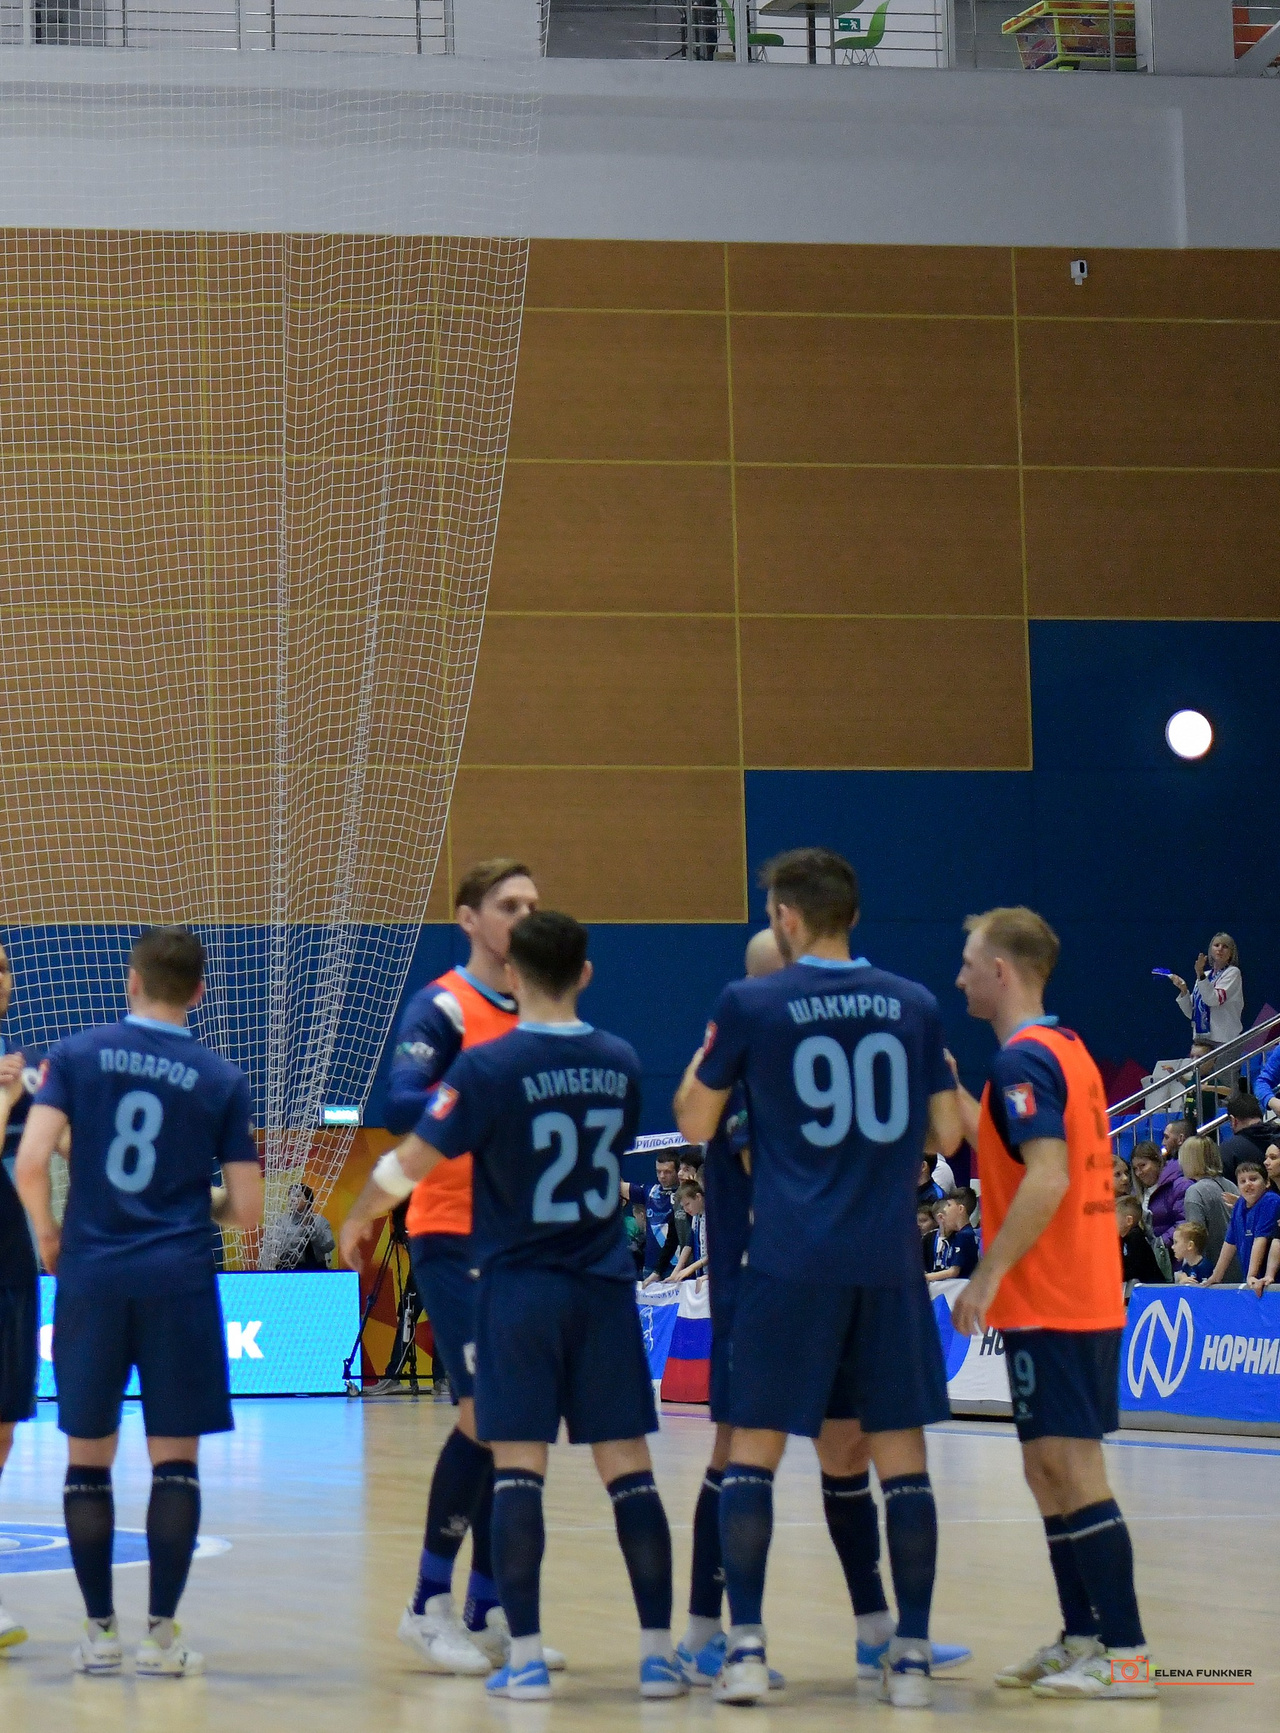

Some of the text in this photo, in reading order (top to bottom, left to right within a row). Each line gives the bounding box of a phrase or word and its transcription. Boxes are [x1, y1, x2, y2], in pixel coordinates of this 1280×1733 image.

[788, 994, 902, 1025] ШАКИРОВ
[100, 1048, 198, 1091] ПОВАРОВ
[522, 1068, 628, 1103] АЛИБЕКОВ
[793, 1032, 910, 1148] 90
[105, 1090, 164, 1193] 8
[532, 1108, 624, 1224] 23
[1200, 1334, 1280, 1375] НОРНИ
